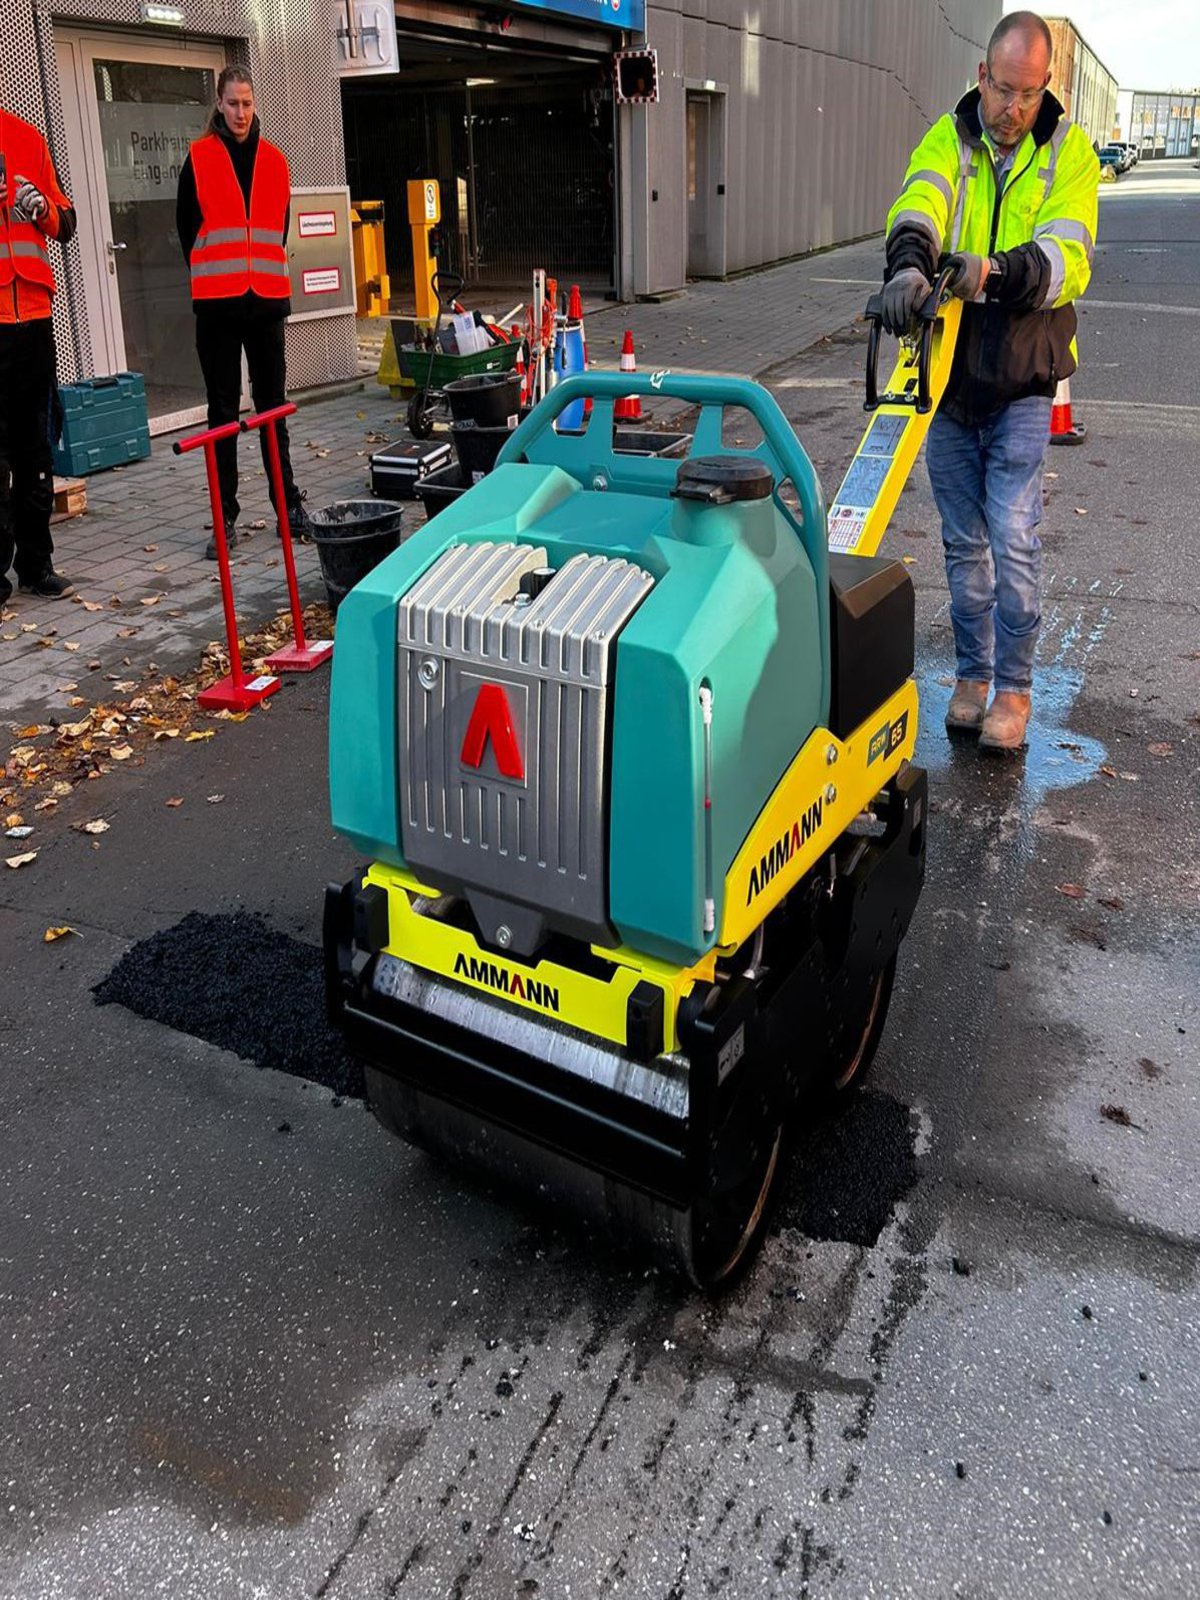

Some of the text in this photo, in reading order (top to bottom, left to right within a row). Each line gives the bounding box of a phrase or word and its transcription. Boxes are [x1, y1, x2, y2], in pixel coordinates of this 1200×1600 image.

[891, 721, 903, 747] 65
[746, 796, 822, 907] AMMANN
[453, 952, 560, 1013] AMMANN
